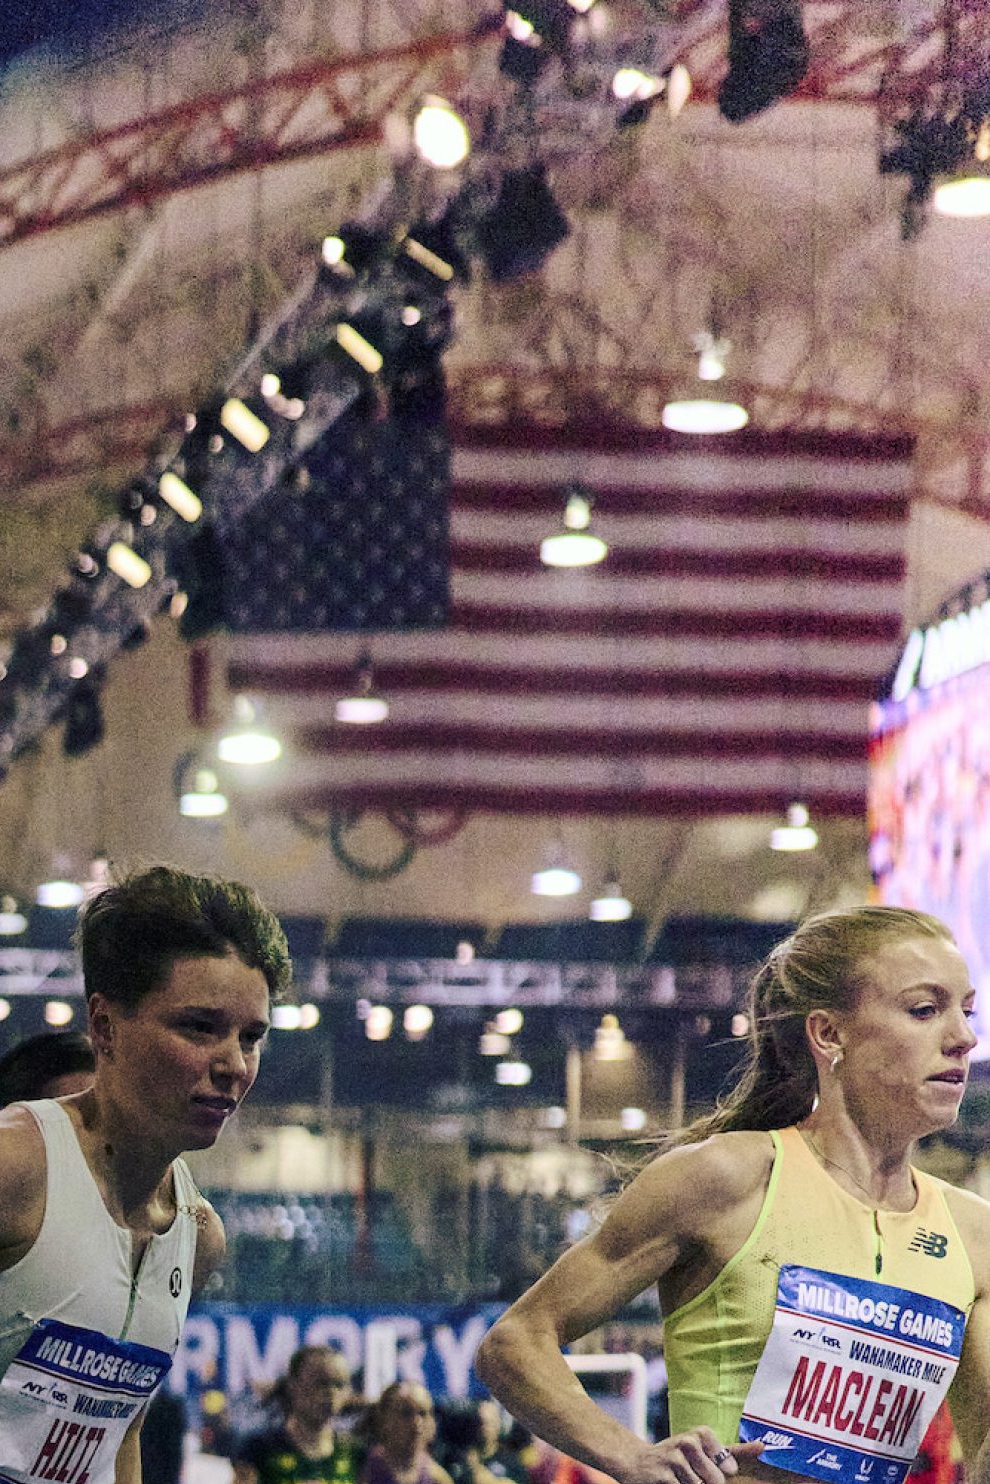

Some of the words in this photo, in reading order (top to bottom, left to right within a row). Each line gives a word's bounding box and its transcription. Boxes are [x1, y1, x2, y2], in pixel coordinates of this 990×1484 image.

[797, 1283, 900, 1331] MILLROSE
[899, 1309, 953, 1347] GAMES
[36, 1336, 123, 1381] MILLROSE
[849, 1340, 923, 1377] WANAMAKER
[921, 1362, 946, 1384] MILE
[781, 1356, 925, 1448] MACLEAN
[30, 1418, 106, 1484] HILTZ
[763, 1431, 794, 1446] RUN
